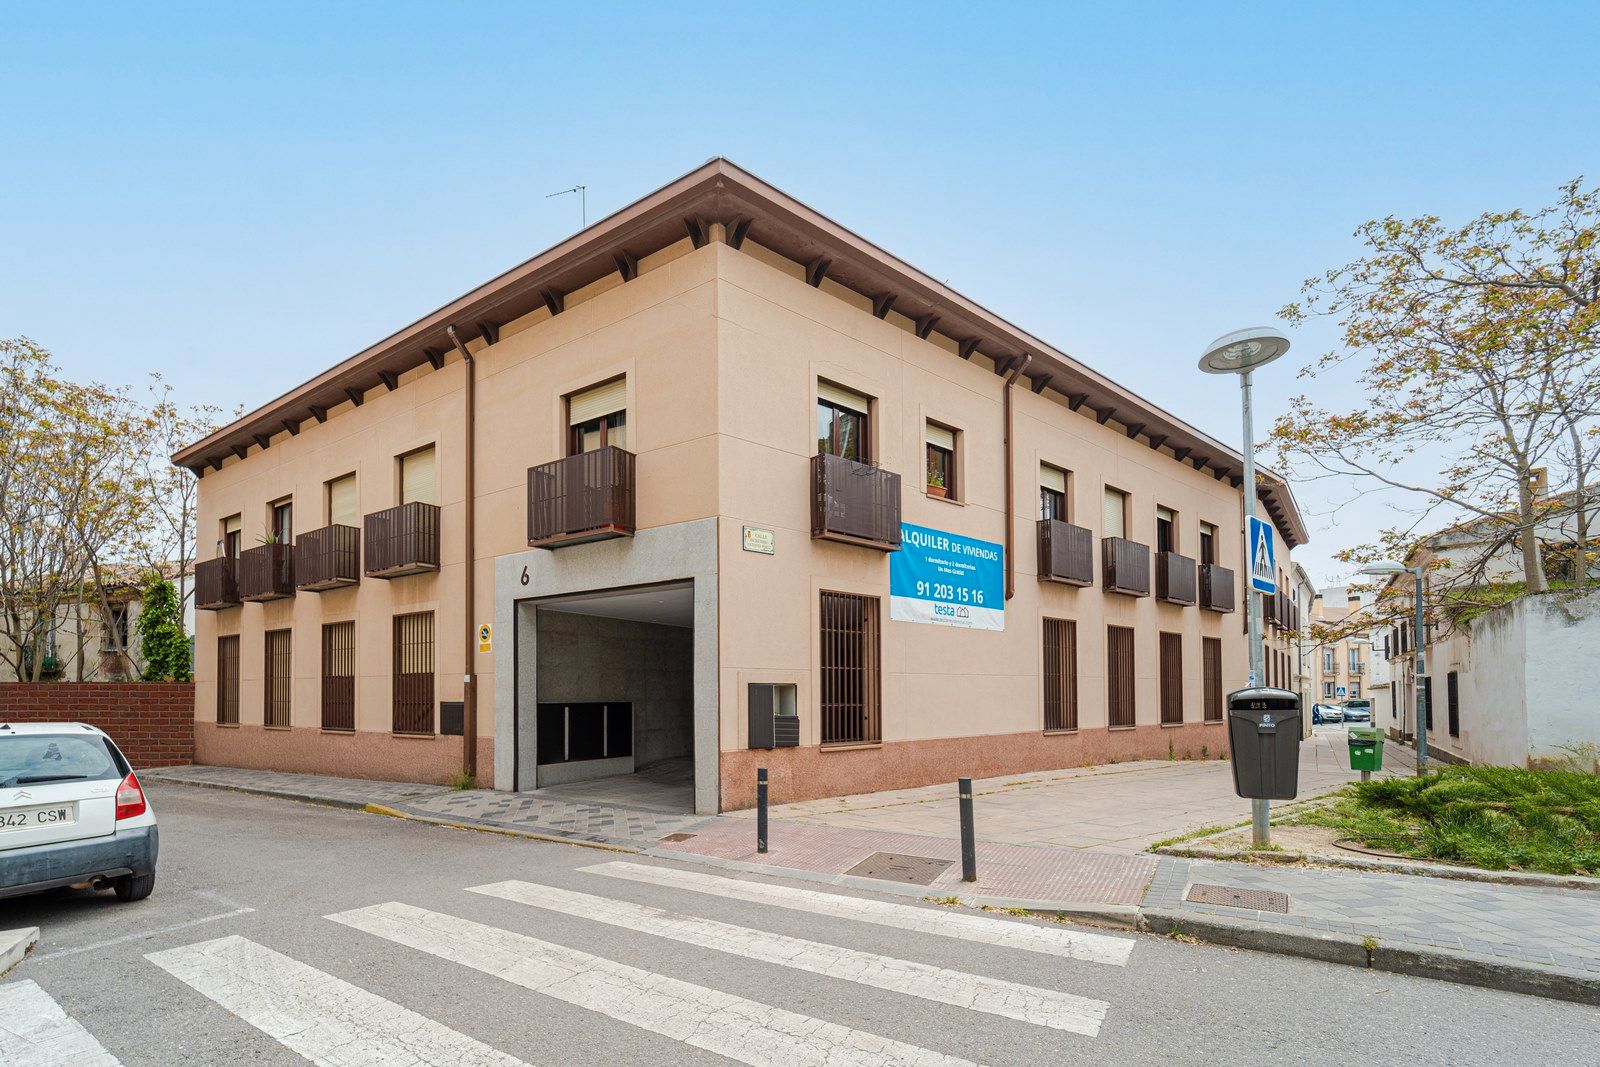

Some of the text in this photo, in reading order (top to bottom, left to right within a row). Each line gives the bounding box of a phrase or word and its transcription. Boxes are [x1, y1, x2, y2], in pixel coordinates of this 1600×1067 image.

[901, 529, 998, 561] ALQUILER DE VIVIENDAS
[928, 556, 948, 566] dormitorio
[520, 565, 530, 586] 6
[916, 580, 984, 604] 91 203 15 16
[934, 603, 955, 617] testa
[37, 809, 67, 823] CSW
